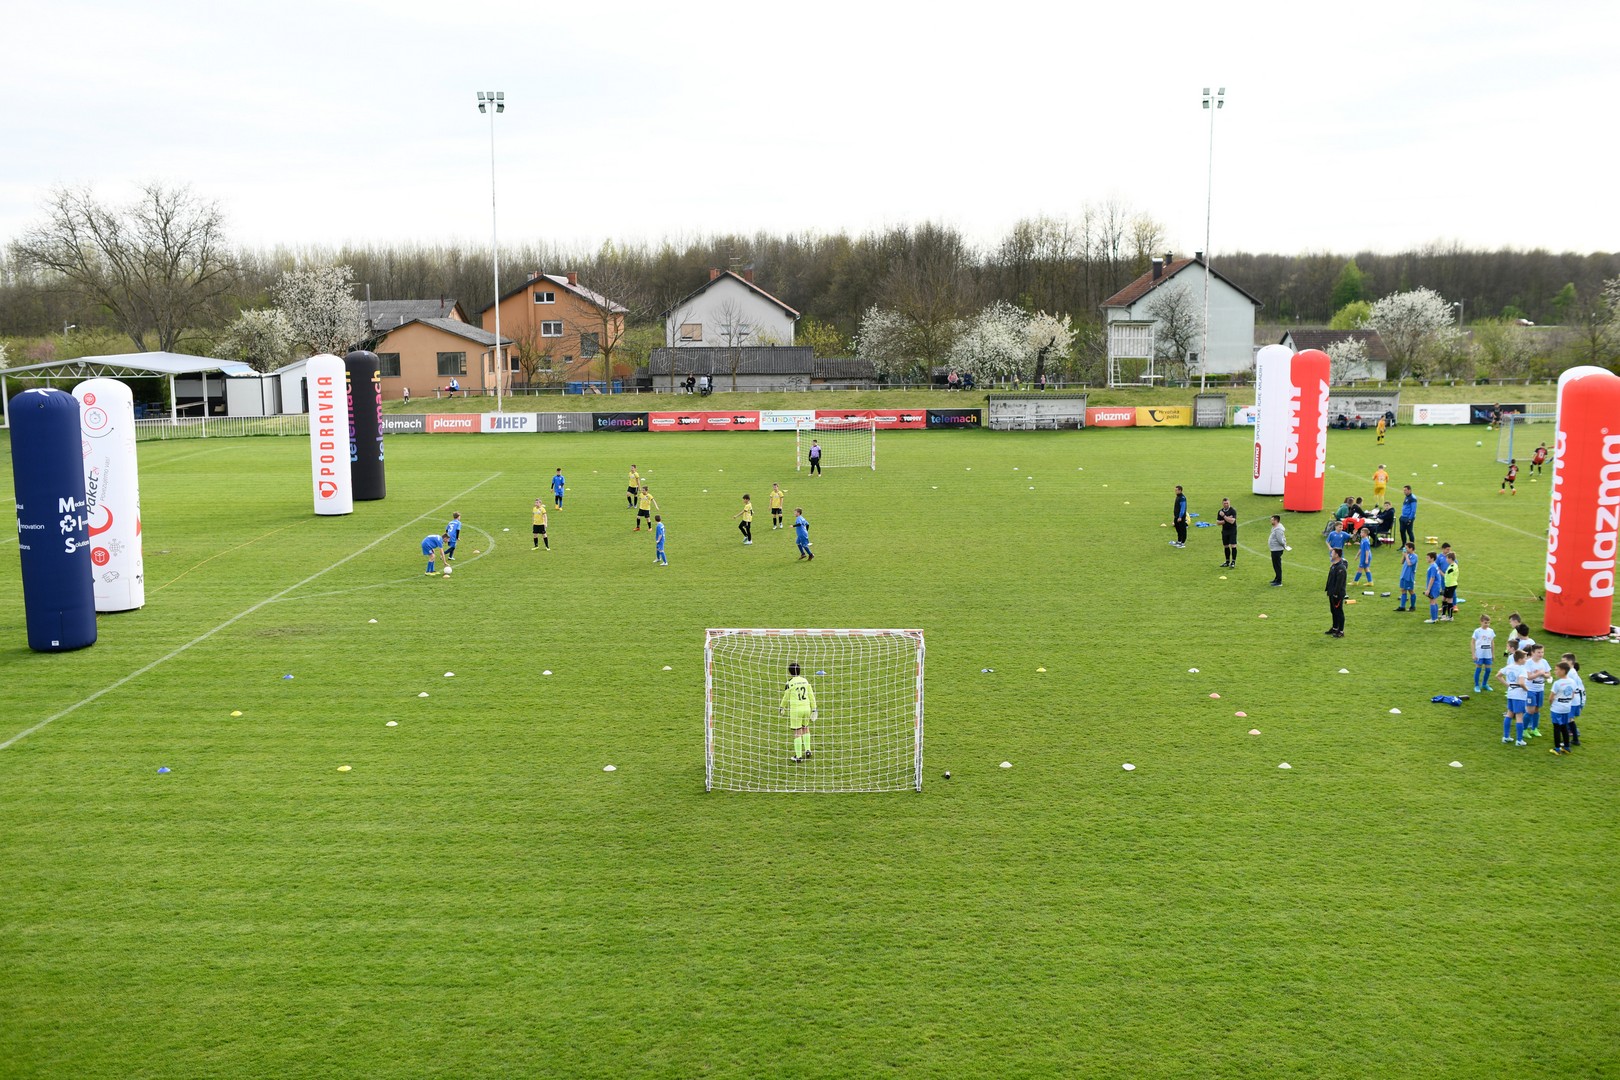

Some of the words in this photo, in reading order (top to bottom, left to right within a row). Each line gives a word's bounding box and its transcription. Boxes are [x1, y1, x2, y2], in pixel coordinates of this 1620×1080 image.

[433, 418, 472, 429] plazma
[503, 417, 528, 429] HEP
[598, 417, 643, 426] telemach
[930, 414, 977, 424] telemach
[1095, 412, 1131, 423] plazma
[317, 376, 335, 475] PODRAVKA
[1285, 385, 1301, 476] TOMMY
[1314, 379, 1330, 478] TOMMY
[86, 470, 99, 515] Paket
[1581, 434, 1620, 598] plazma
[18, 518, 45, 533] Innovation
[65, 537, 90, 554] Solution
[795, 686, 807, 701] 12
